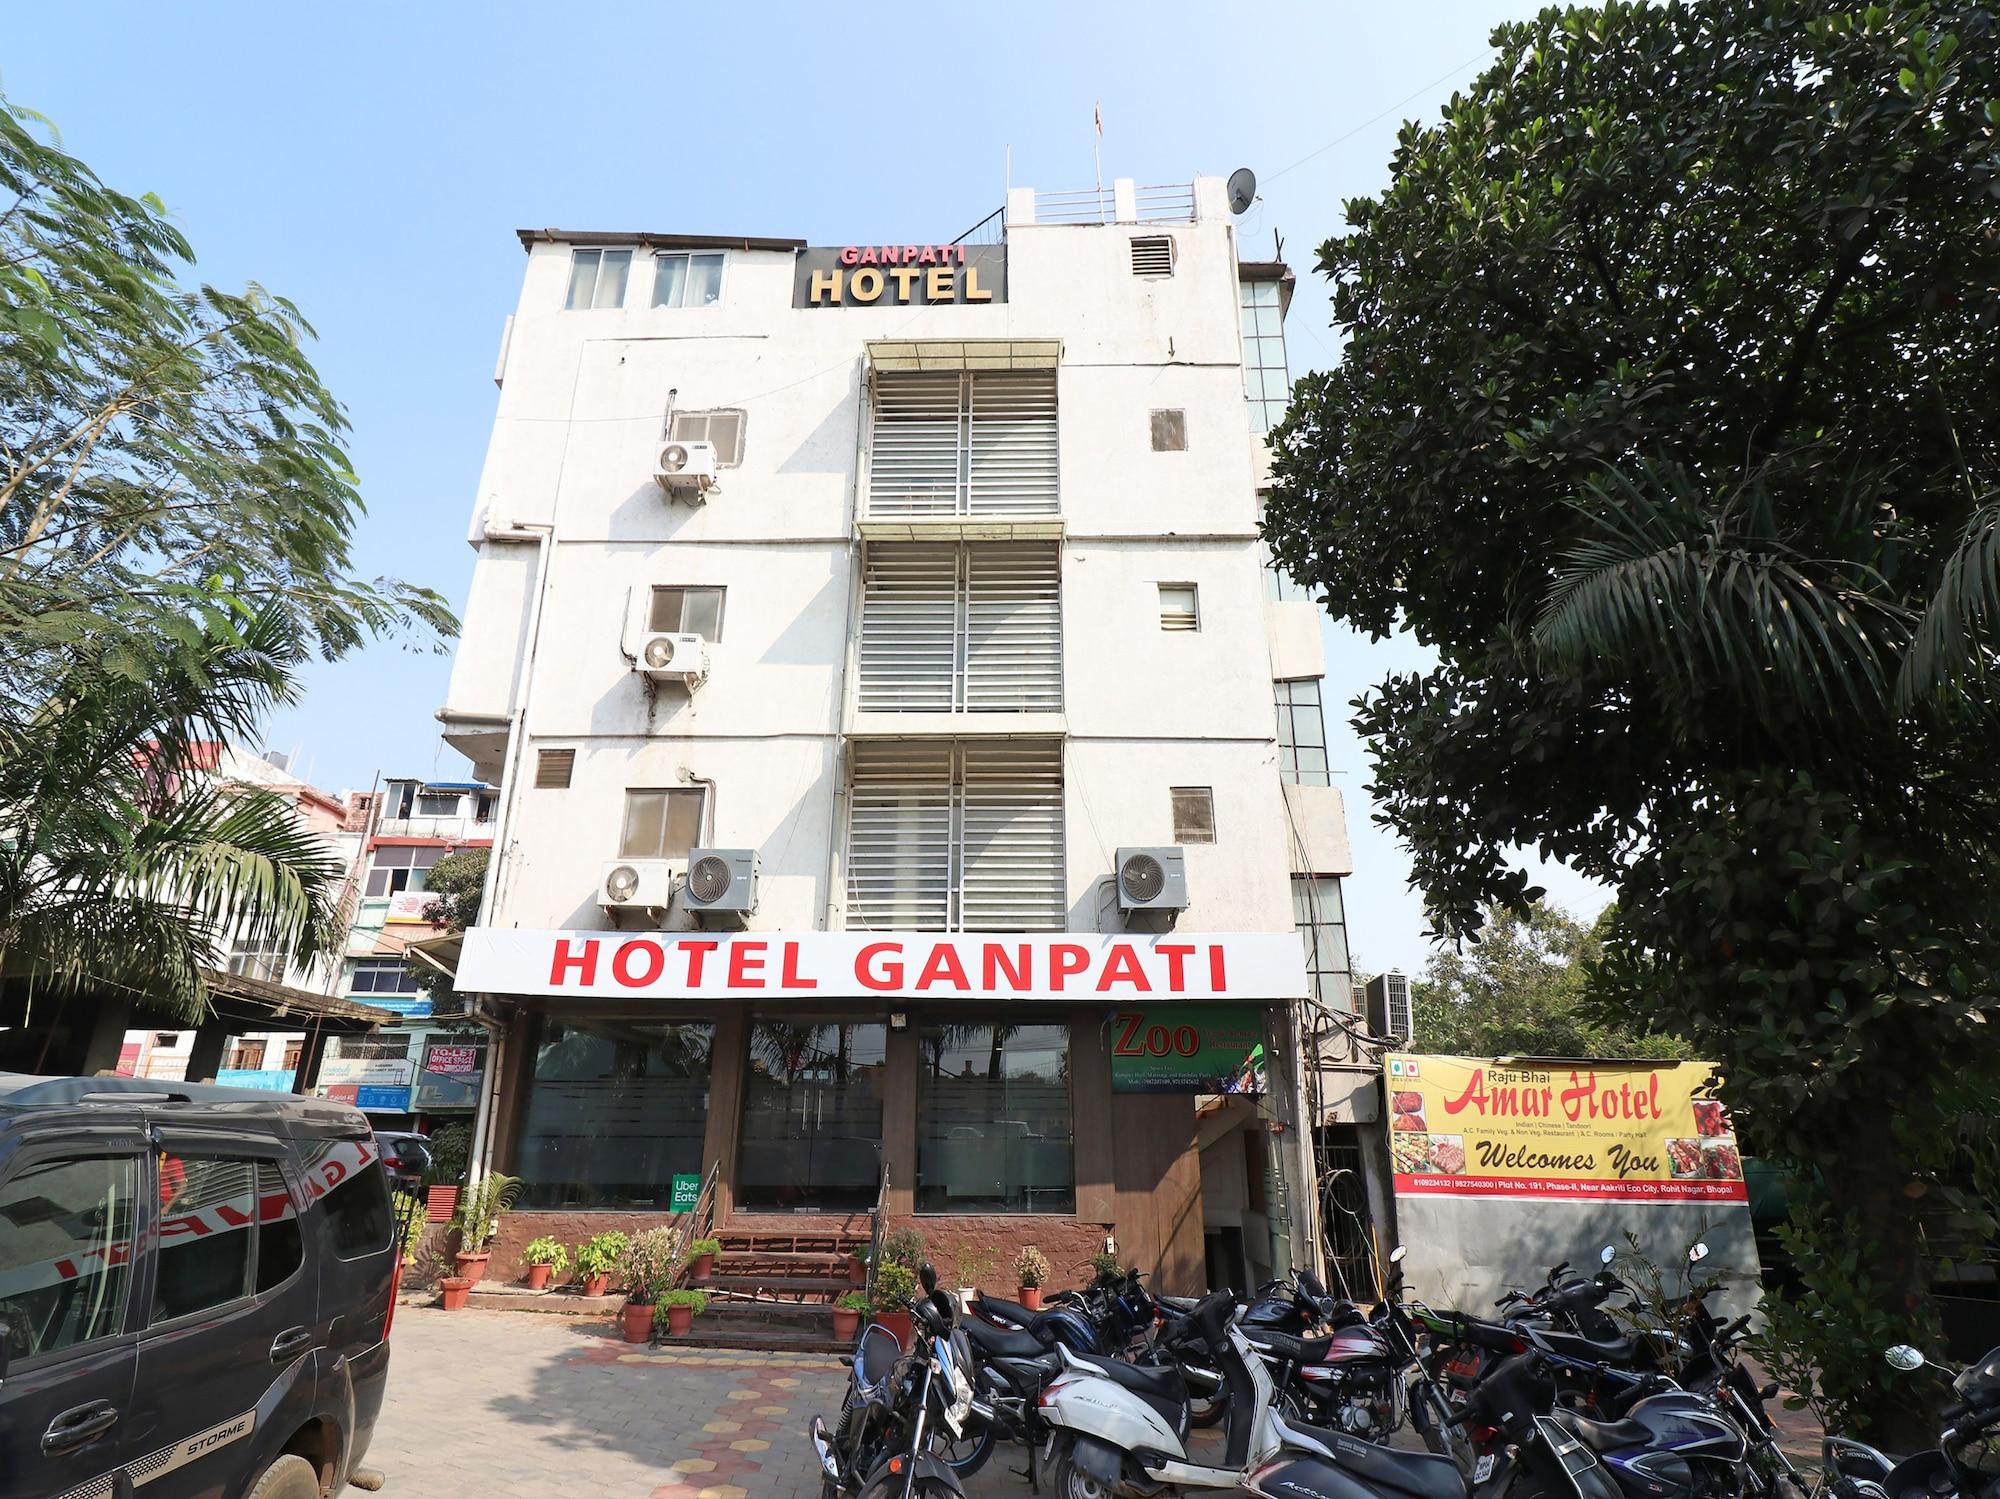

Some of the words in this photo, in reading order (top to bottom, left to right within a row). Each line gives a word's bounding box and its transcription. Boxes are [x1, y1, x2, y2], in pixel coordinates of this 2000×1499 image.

[841, 245, 965, 265] GANPATI
[810, 267, 993, 303] HOTEL
[549, 939, 817, 989] HOTEL
[854, 942, 1227, 992] GANPATI
[1113, 1013, 1199, 1056] Zoo
[1488, 1070, 1517, 1085] Raju
[1521, 1071, 1550, 1083] Bhai
[1443, 1068, 1553, 1117] Amar
[1560, 1070, 1662, 1122] Hotel
[1476, 1128, 1495, 1136] Family
[1619, 1131, 1634, 1139] Party
[1475, 1140, 1597, 1170] Welcomes
[1607, 1143, 1659, 1179] You
[675, 1180, 699, 1191] Uber
[1498, 1181, 1513, 1189] Plot
[1517, 1182, 1527, 1190] No.
[1580, 1184, 1599, 1192] Near
[1600, 1184, 1626, 1192] Aakriti
[1627, 1185, 1641, 1193] Eco
[1661, 1185, 1681, 1193] Rohit
[1707, 1185, 1733, 1194] Bhopal
[674, 1191, 698, 1202] Eats
[187, 1421, 245, 1456] STORME
[1847, 1452, 1873, 1460] HONDA
